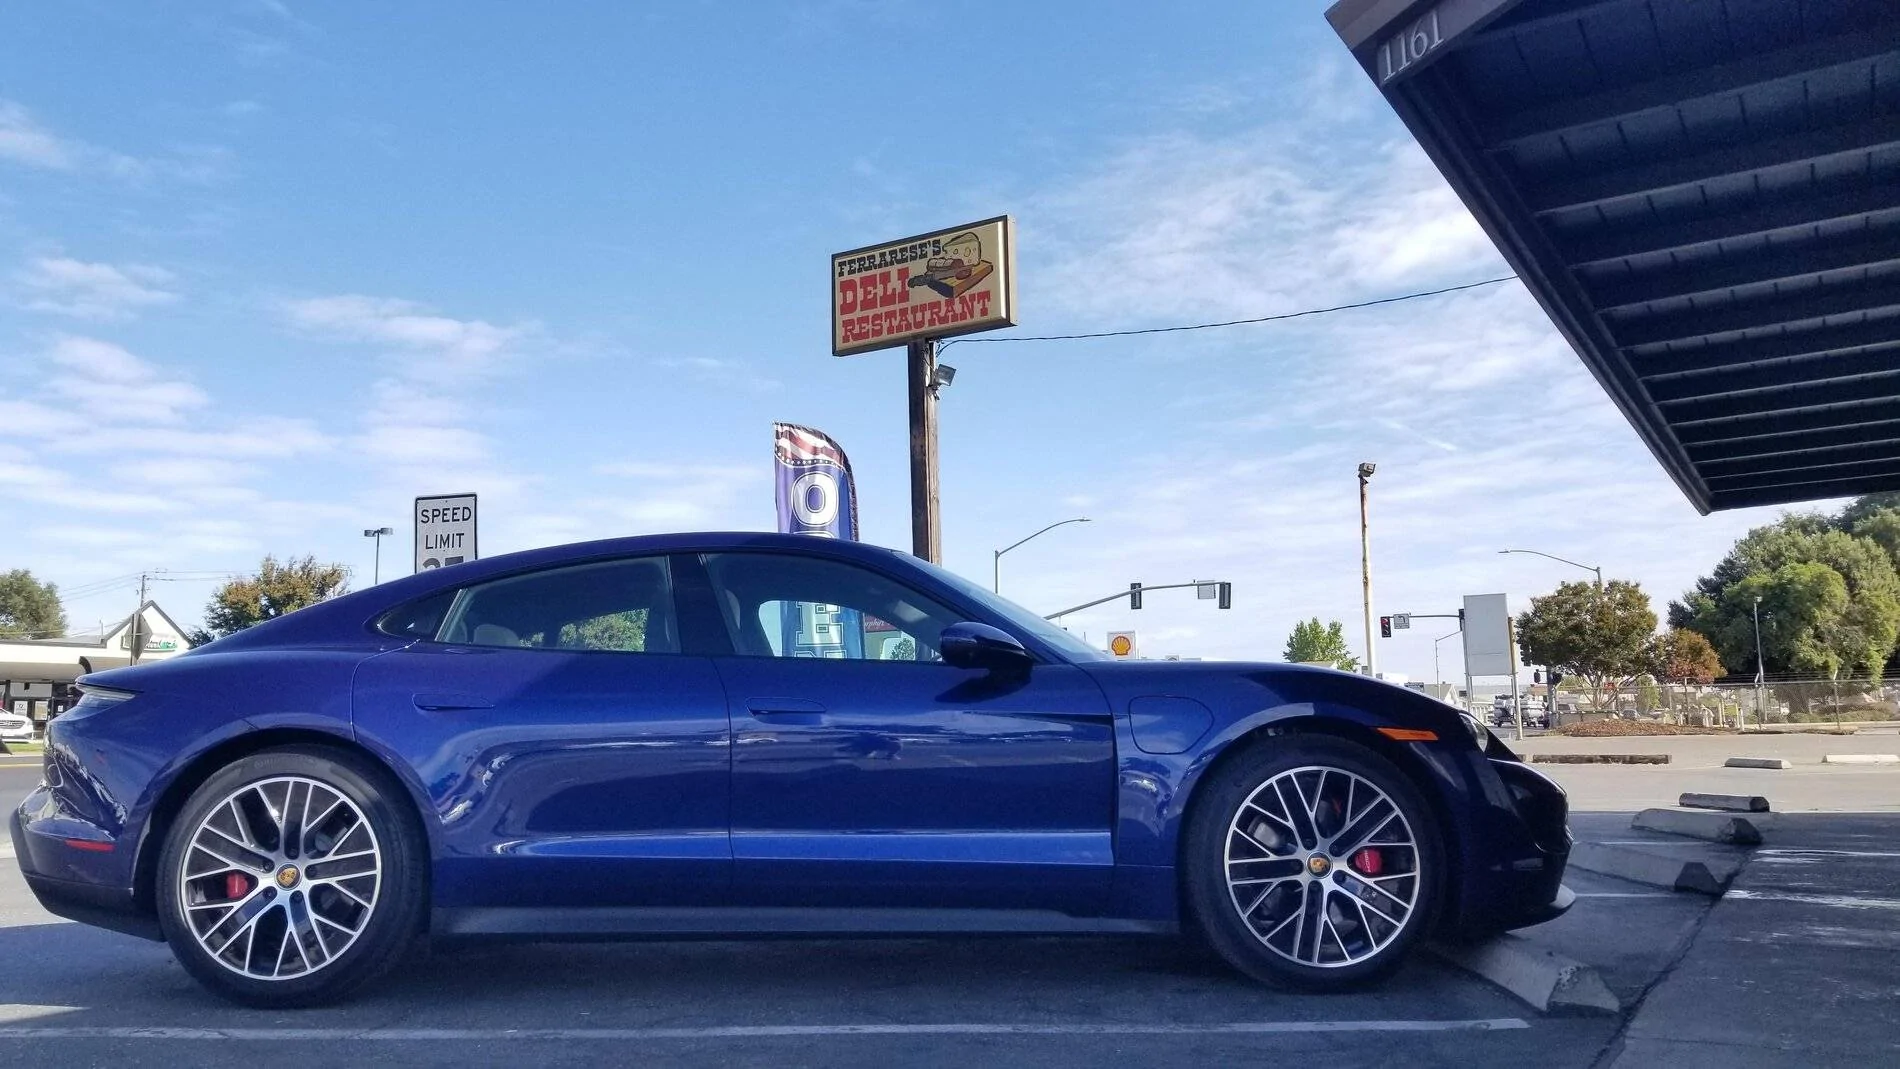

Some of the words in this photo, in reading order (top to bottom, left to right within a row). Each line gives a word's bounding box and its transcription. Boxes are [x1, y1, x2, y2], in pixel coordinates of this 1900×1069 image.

[1382, 9, 1444, 81] 1161
[838, 239, 942, 277] FERRARESE'S
[839, 266, 910, 316] DELI
[841, 290, 991, 343] RESTAURANT
[420, 506, 472, 524] SPEED
[425, 532, 465, 550] LIMIT
